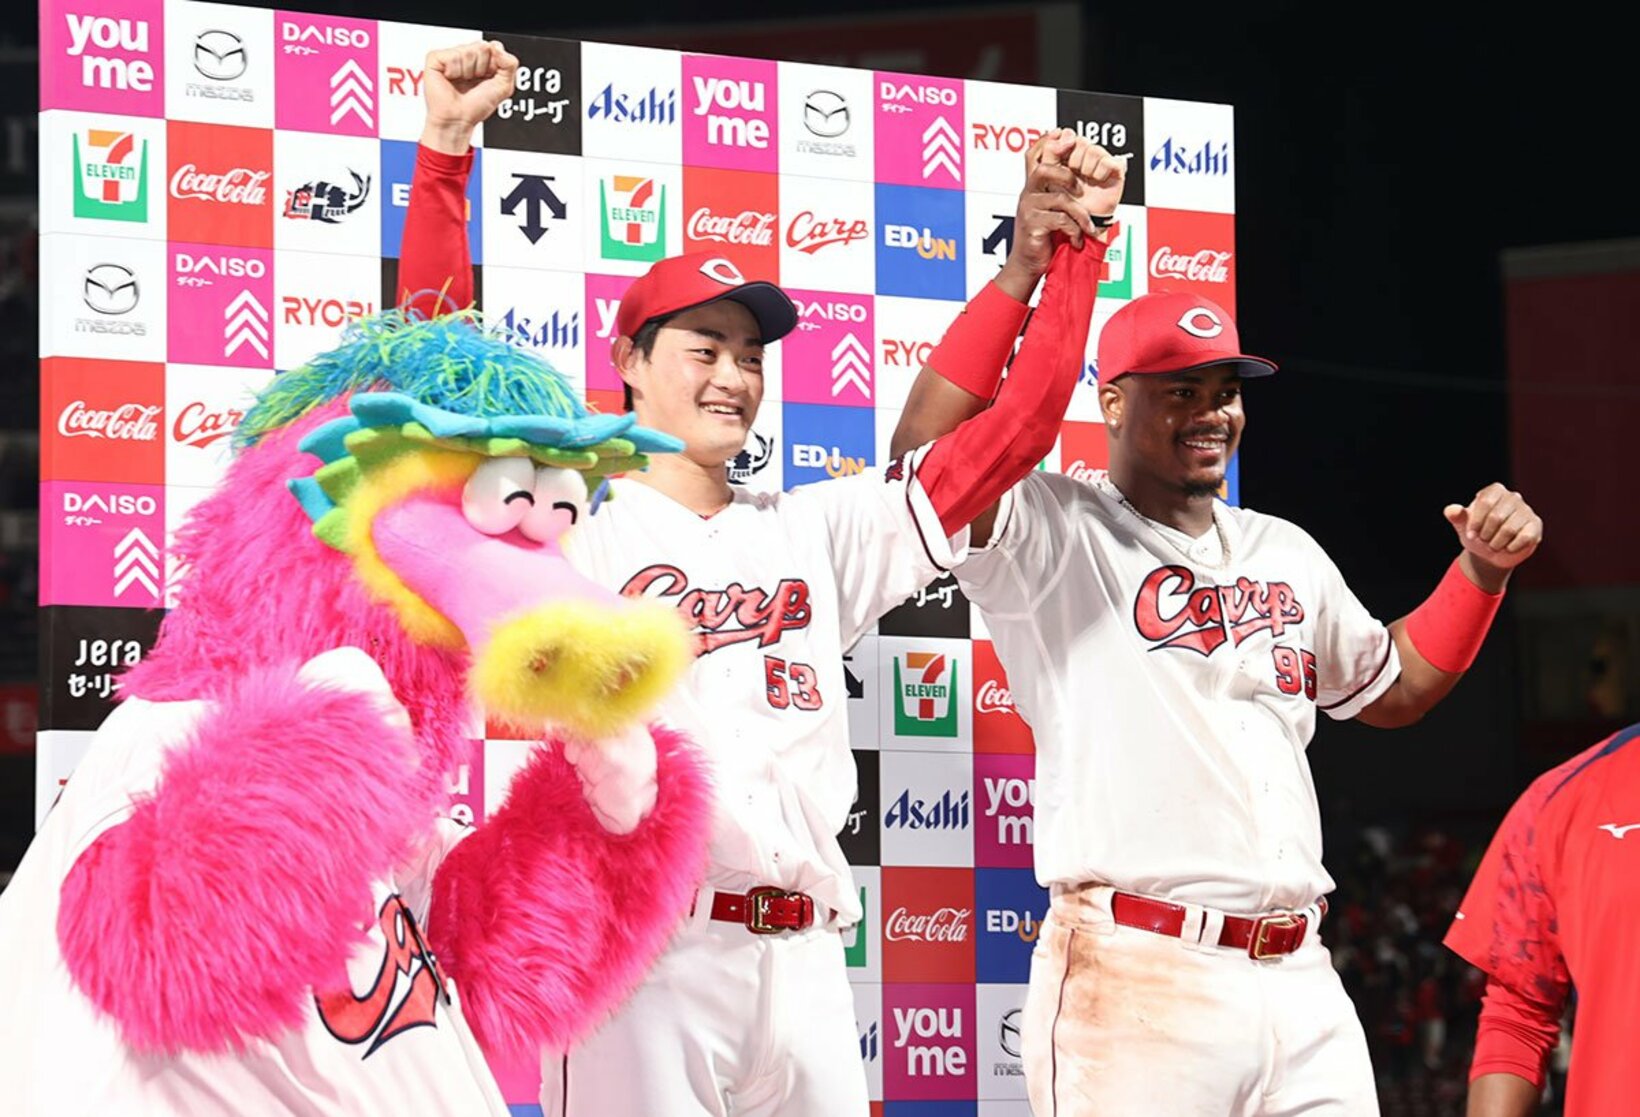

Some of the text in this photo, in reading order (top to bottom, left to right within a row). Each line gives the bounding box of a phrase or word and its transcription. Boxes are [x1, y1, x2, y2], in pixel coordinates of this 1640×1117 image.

[66, 14, 149, 56] you
[283, 22, 370, 49] DAISO
[82, 55, 154, 92] me
[515, 65, 561, 95] era
[588, 83, 676, 125] Asahi
[692, 76, 765, 114] you
[880, 82, 957, 106] DAISO
[706, 114, 770, 149] me
[1150, 136, 1230, 177] Asahi
[786, 211, 869, 255] Carp
[884, 224, 956, 261] EDION
[176, 254, 266, 279] DAISO
[173, 402, 246, 449] Car
[793, 444, 866, 478] EDION
[63, 493, 156, 516] DAISO
[619, 563, 813, 659] Carp
[1133, 564, 1305, 658] Carp
[74, 638, 141, 667] Jera
[764, 655, 823, 711] 53
[1271, 645, 1317, 702] 95
[884, 788, 969, 830] Asahi
[984, 778, 1036, 816] yo
[997, 815, 1035, 845] m
[885, 906, 972, 942] Coca-Cola
[986, 909, 1041, 942] EDIO
[893, 1007, 963, 1048] you
[906, 1045, 967, 1077] me
